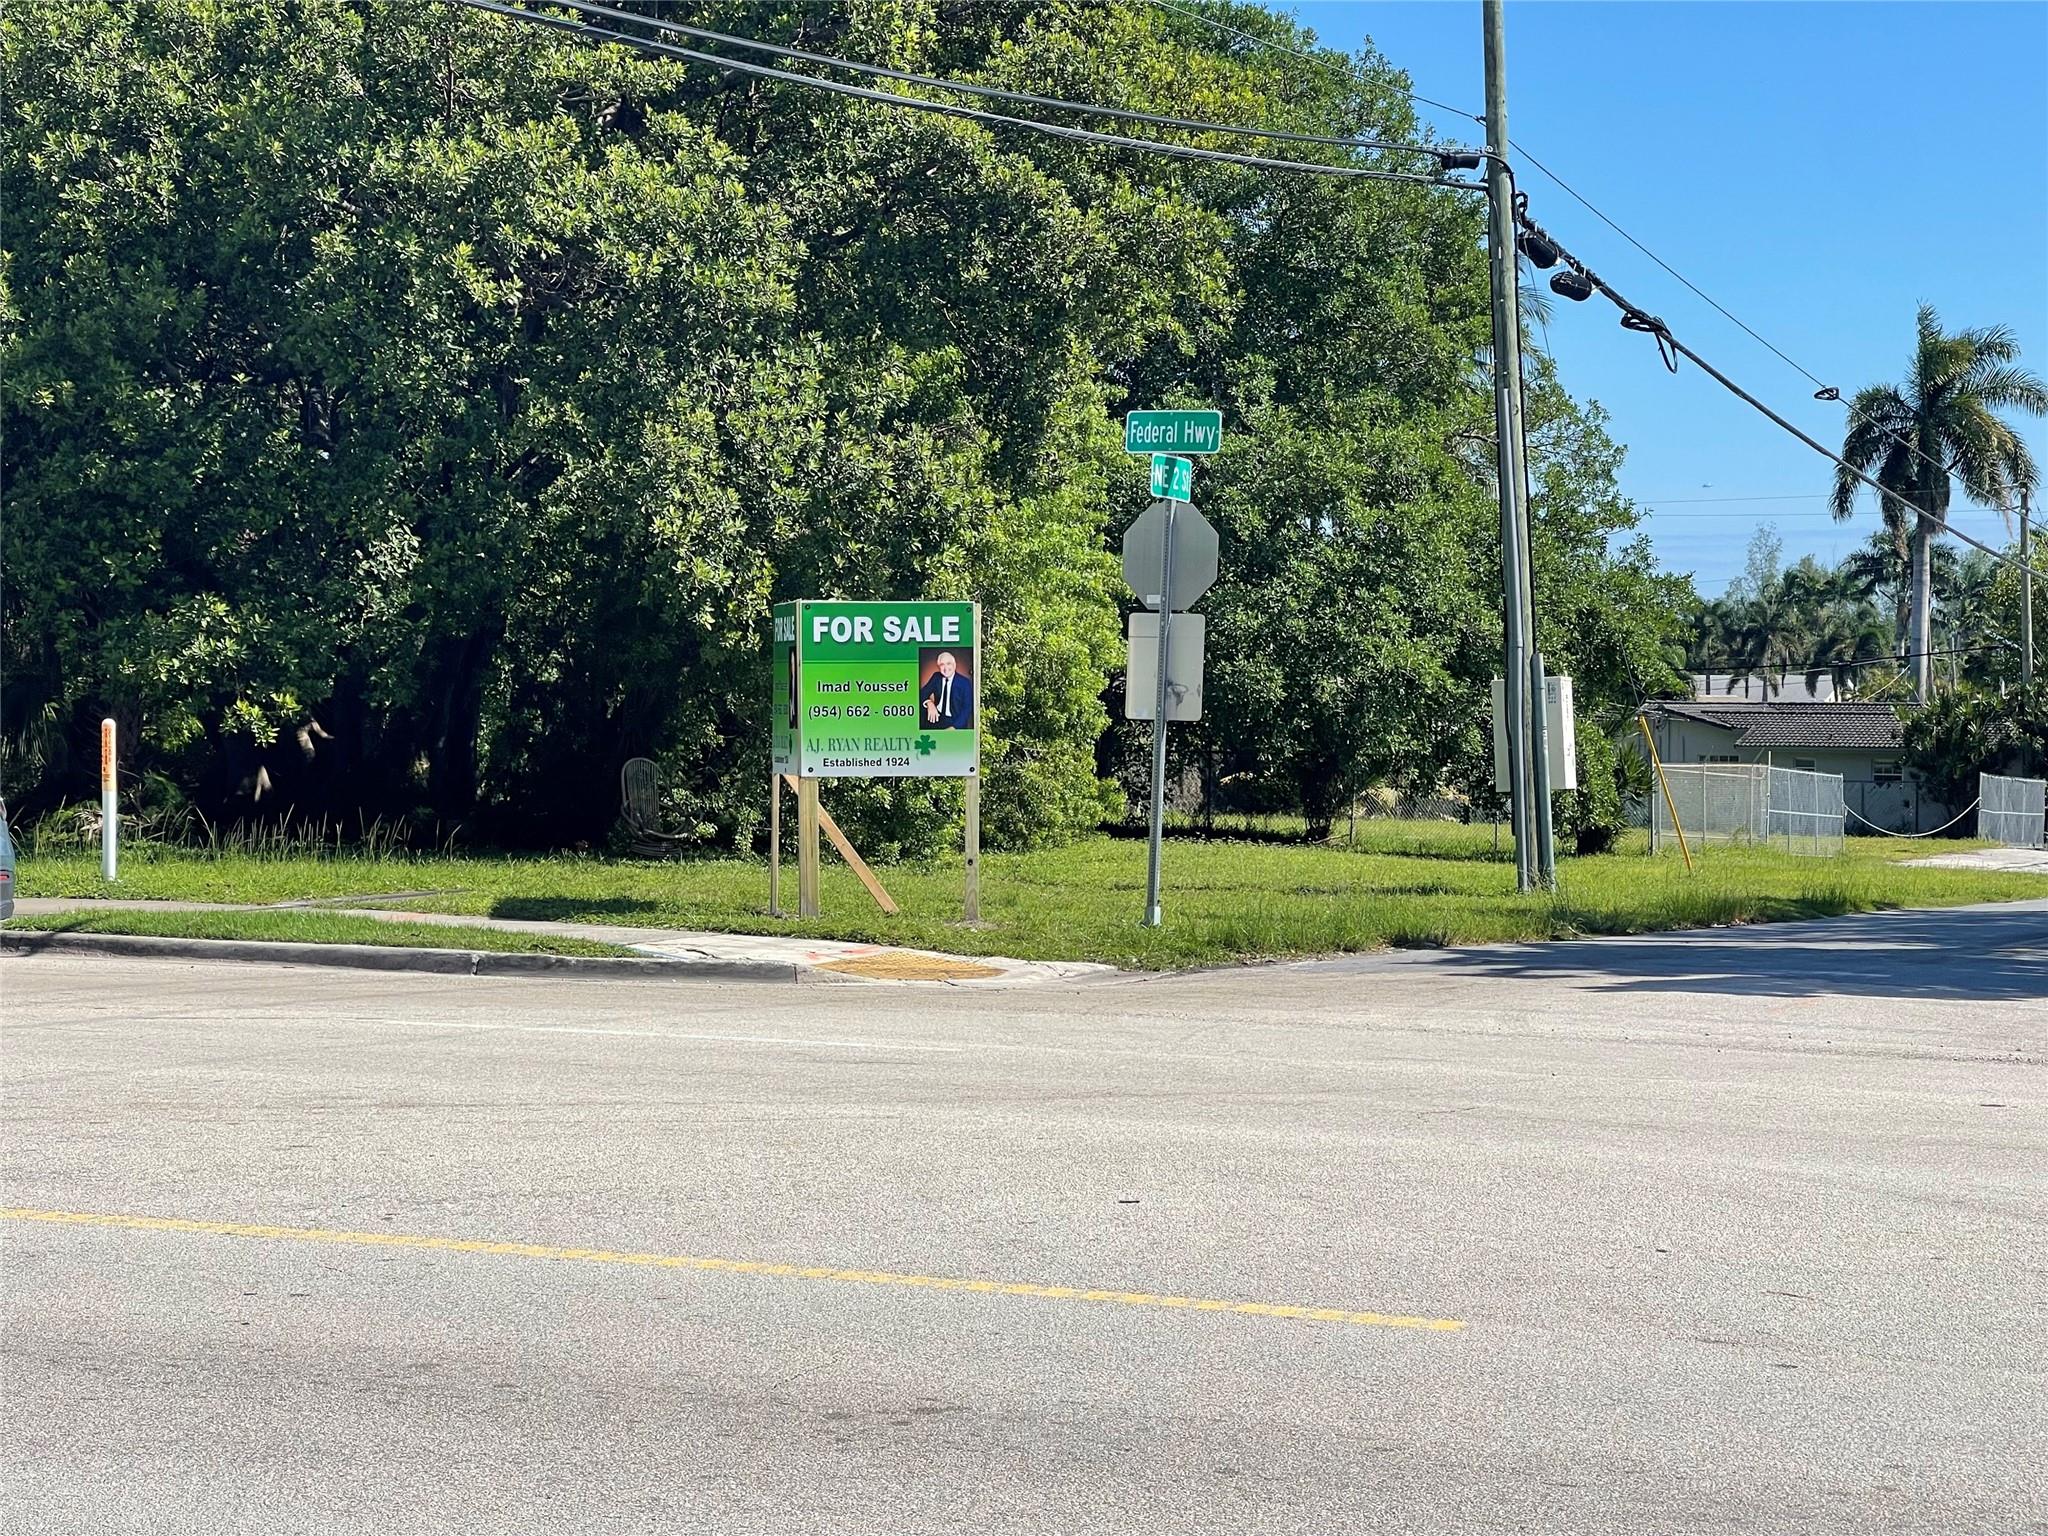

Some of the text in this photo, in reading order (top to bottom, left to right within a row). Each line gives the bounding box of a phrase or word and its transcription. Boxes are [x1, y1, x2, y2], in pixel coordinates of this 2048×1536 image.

[1130, 420, 1215, 449] Federal Hwy
[1154, 463, 1190, 493] NE 2 St
[813, 616, 960, 643] FOR SALE
[817, 680, 909, 693] Imad Youssef
[808, 705, 842, 720] (954)
[846, 705, 870, 717] 662
[883, 705, 915, 717] 6080
[828, 738, 860, 752] RYAN
[864, 738, 912, 752] REALTY
[823, 757, 910, 768] Established 1924
